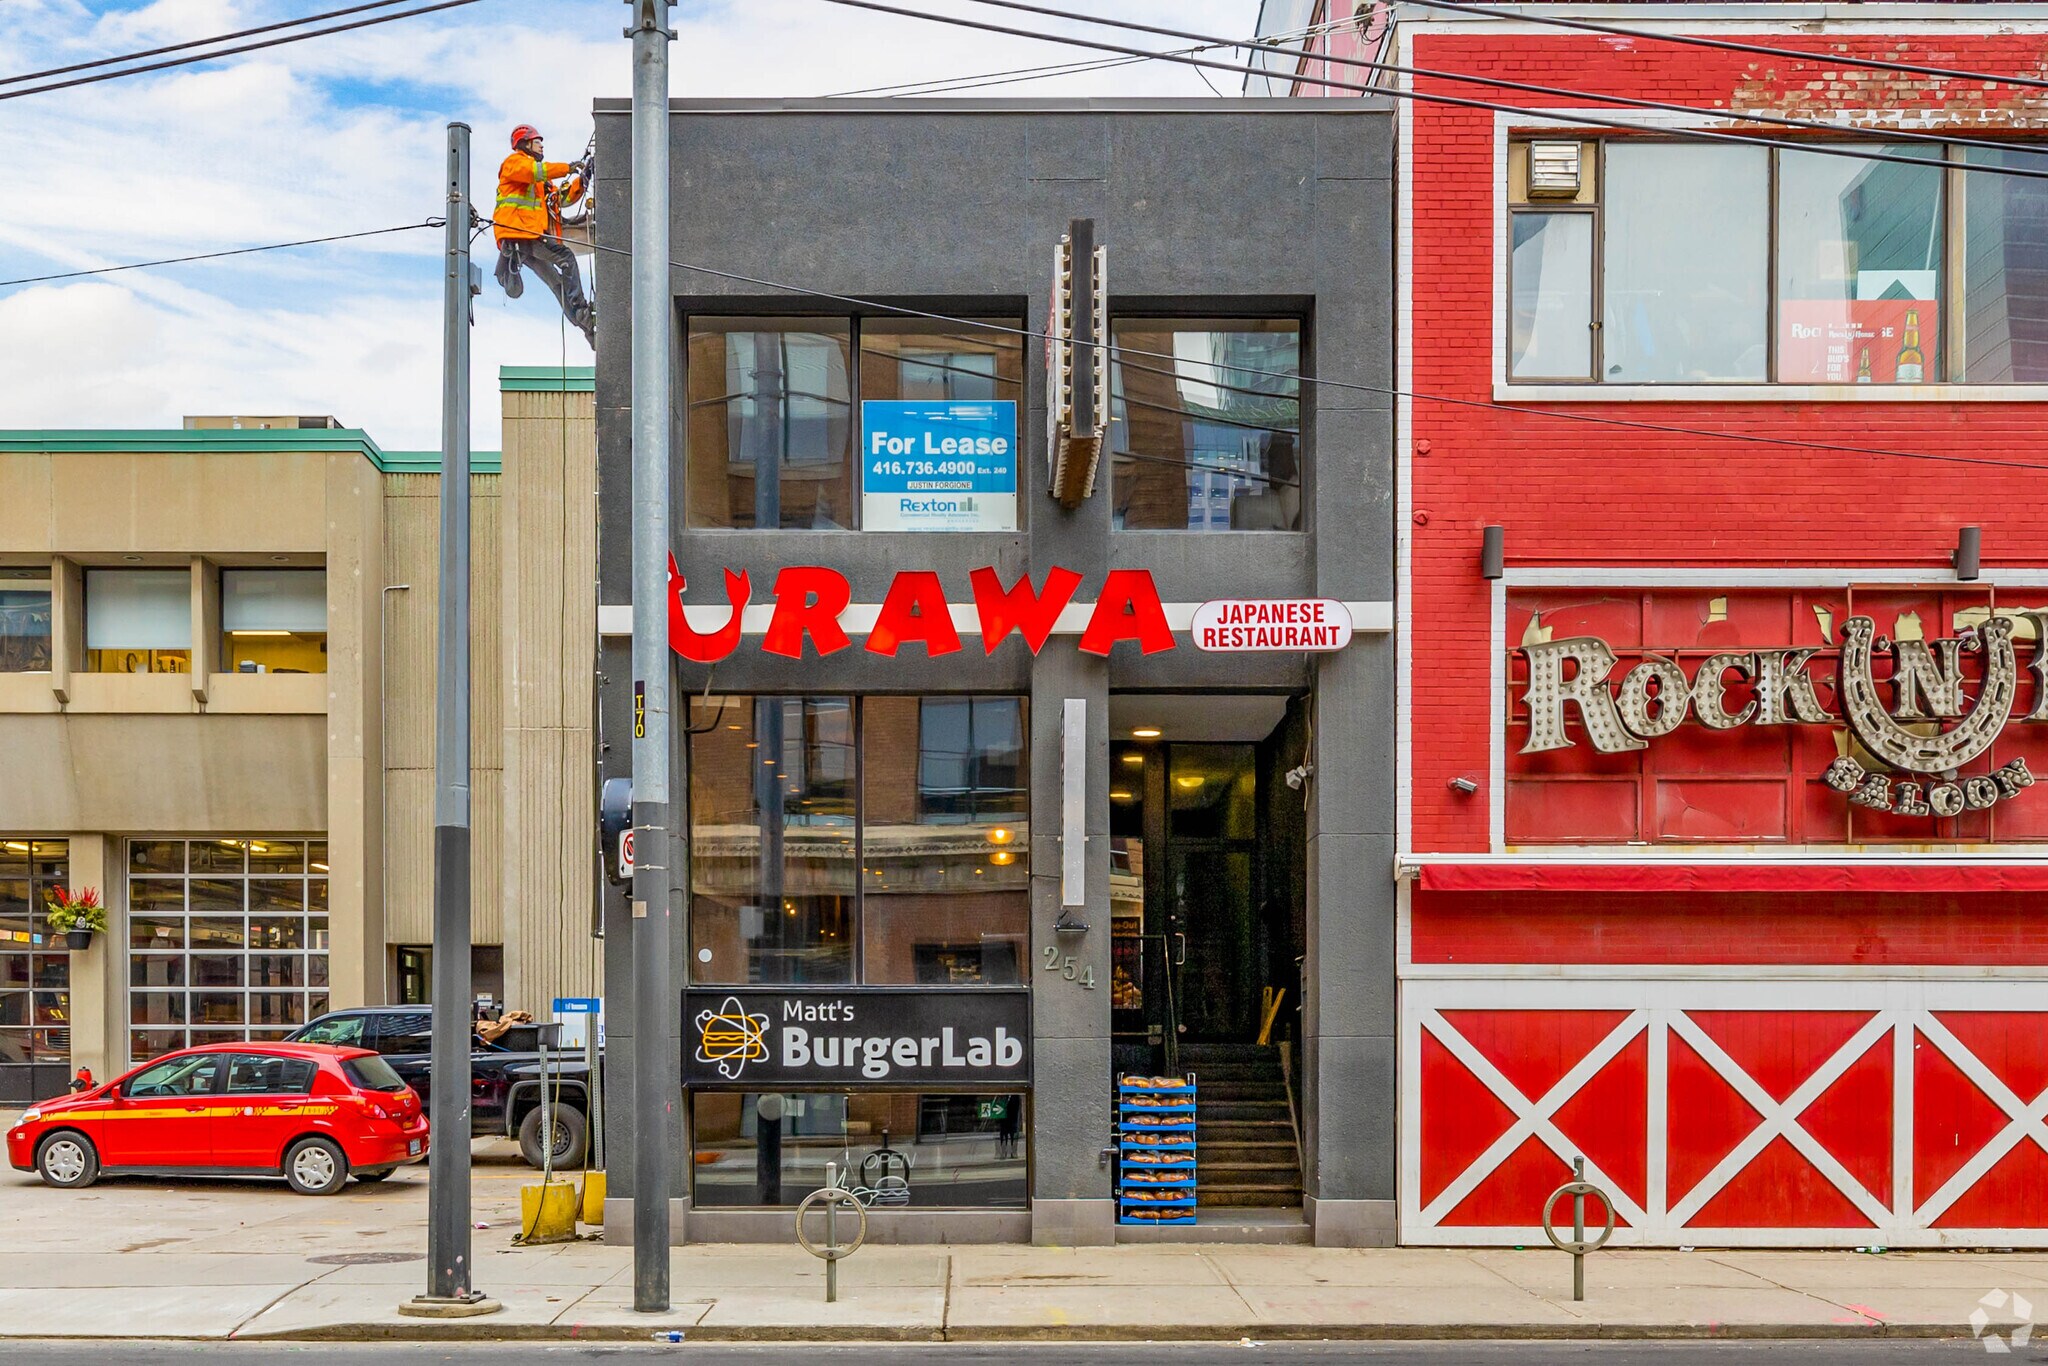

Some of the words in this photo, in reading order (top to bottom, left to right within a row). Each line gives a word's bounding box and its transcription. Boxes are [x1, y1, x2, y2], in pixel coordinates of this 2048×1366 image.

[871, 431, 915, 454] For
[924, 431, 1008, 454] Lease
[872, 461, 975, 475] 416.736.4900
[900, 498, 957, 512] Rexton
[669, 549, 1177, 663] URAWA
[1217, 603, 1325, 625] JAPANESE
[1203, 626, 1341, 647] RESTAURANT
[1822, 756, 2035, 817] SALOON
[1044, 945, 1096, 990] 254
[783, 999, 855, 1022] Matt's
[782, 1027, 1023, 1079] BurgerLab
[863, 1152, 918, 1169] OPEN
